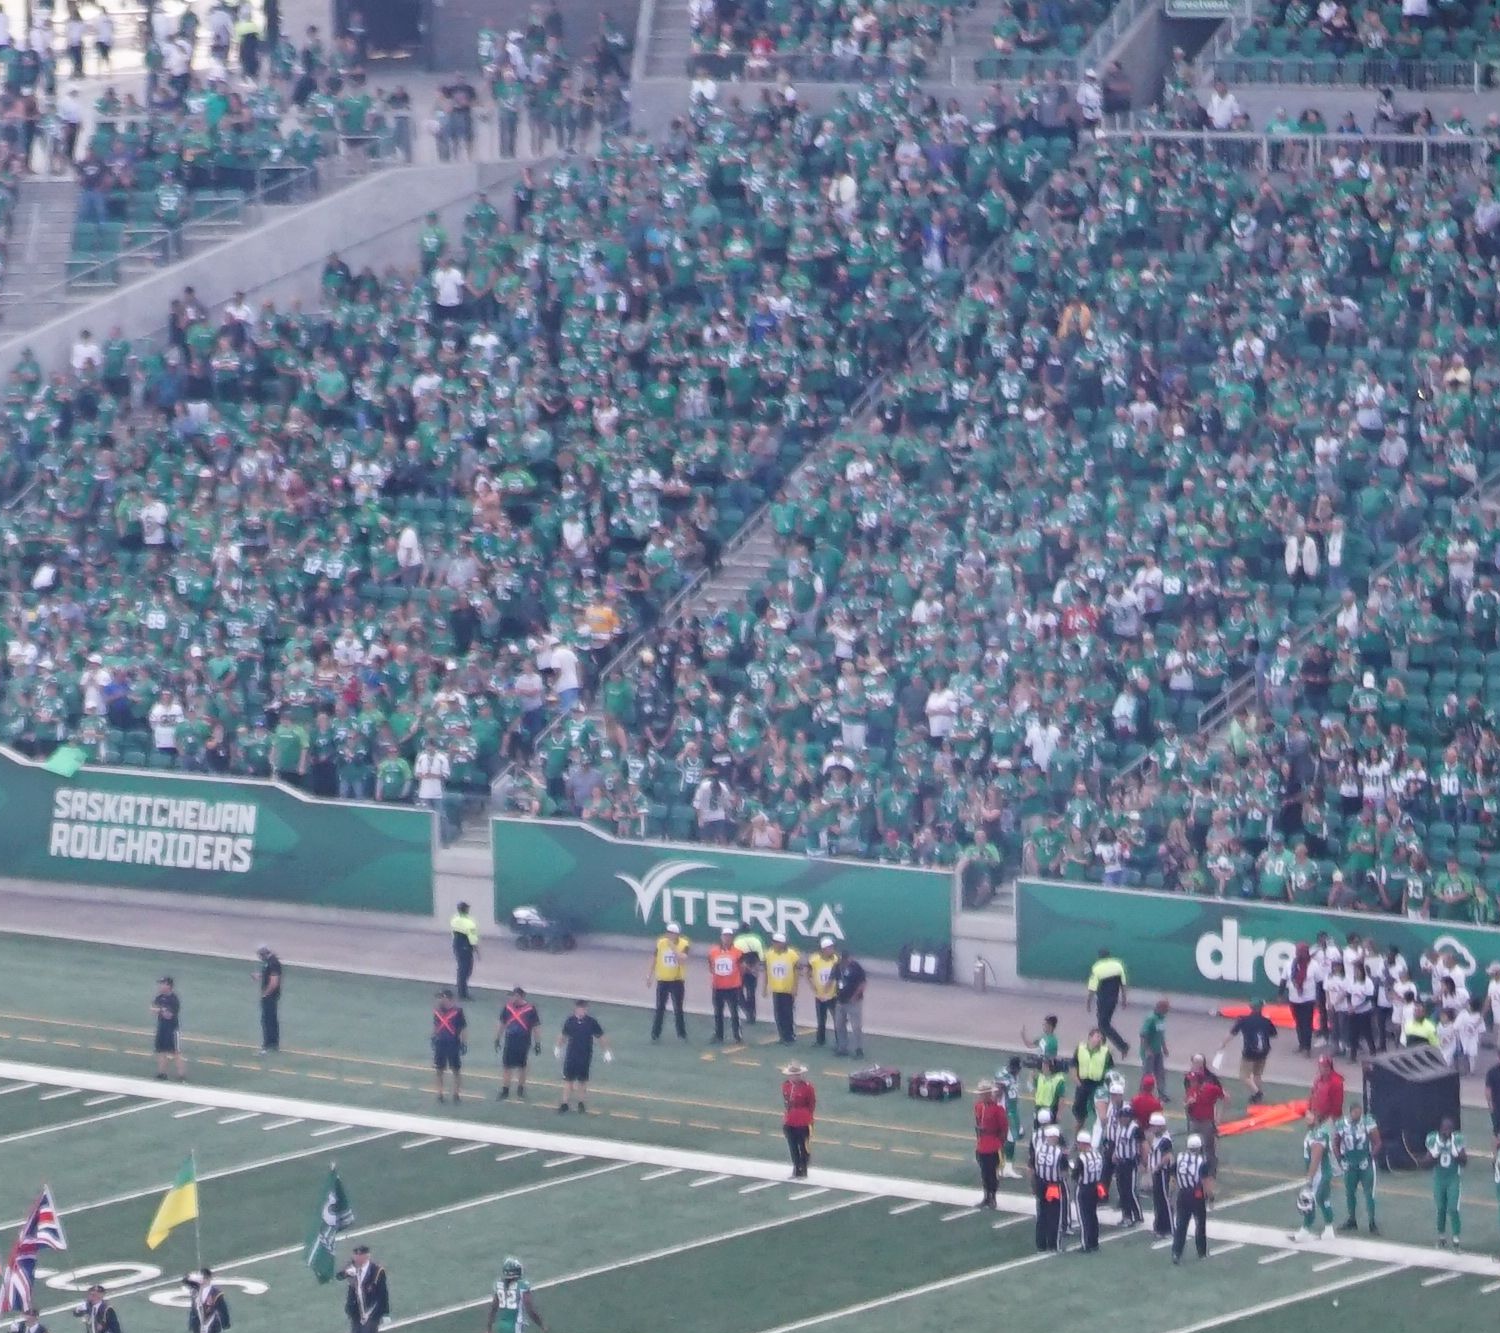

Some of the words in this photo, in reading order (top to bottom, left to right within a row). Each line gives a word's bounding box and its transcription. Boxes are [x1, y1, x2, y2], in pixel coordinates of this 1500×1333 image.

[53, 787, 256, 835] SASKATCHEWAN
[49, 822, 254, 873] ROUGHRIDERS
[614, 859, 845, 940] VITERRA
[1037, 1152, 1053, 1164] 59
[1179, 1161, 1194, 1174] 24
